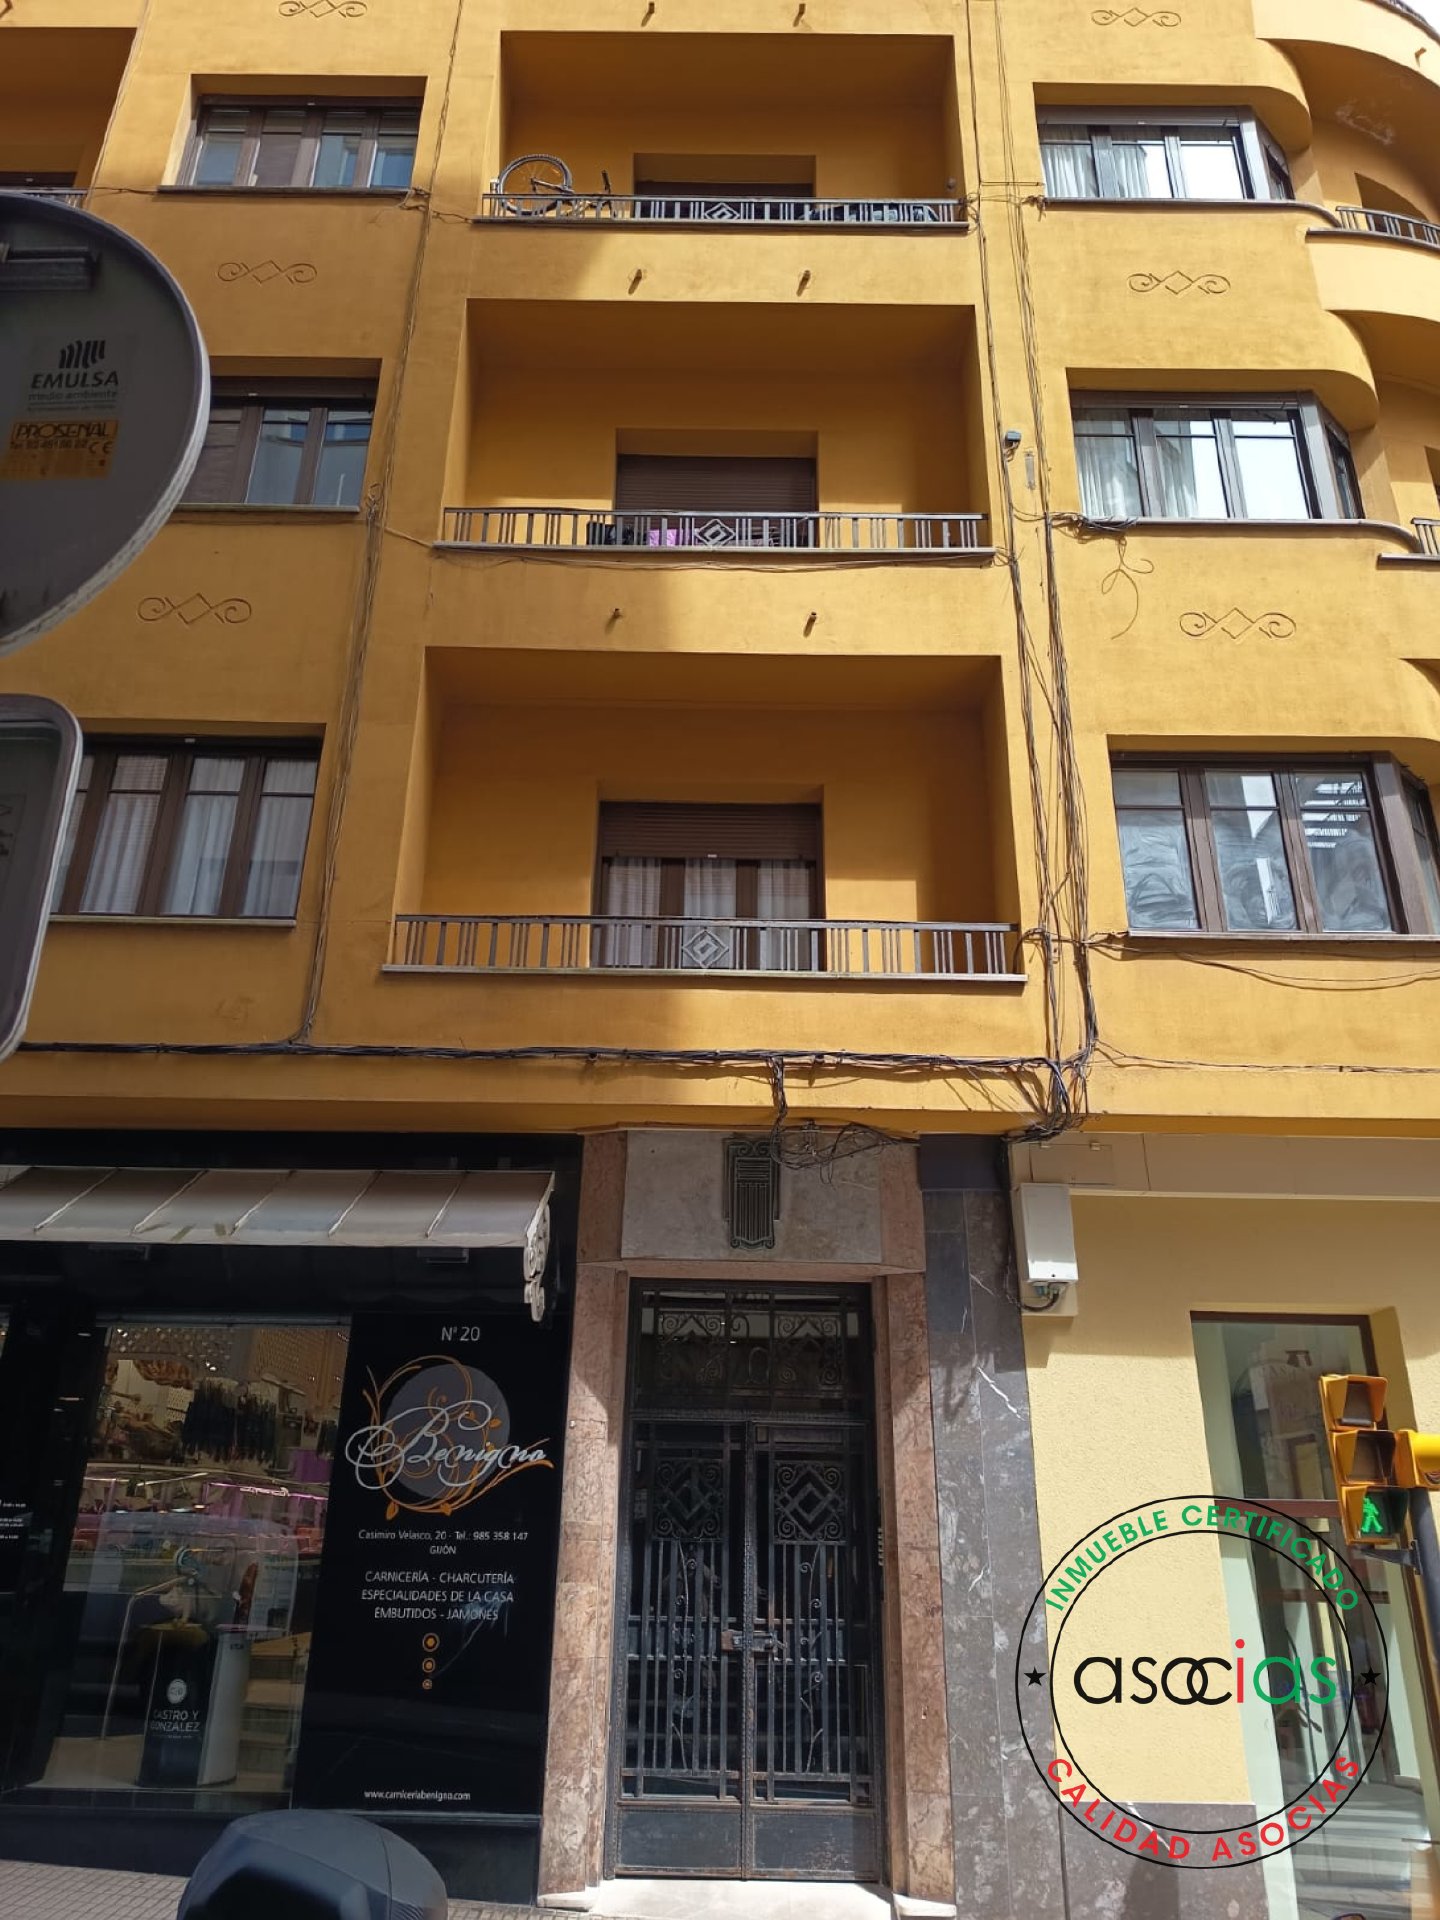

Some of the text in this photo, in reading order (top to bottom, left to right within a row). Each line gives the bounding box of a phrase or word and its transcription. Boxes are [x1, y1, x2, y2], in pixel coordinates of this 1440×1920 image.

[31, 370, 119, 389] EMULSA
[16, 423, 108, 440] PROSENAL
[460, 1326, 480, 1341] 20
[358, 1529, 396, 1539] Casimiro
[398, 1530, 432, 1541] Velasco,
[435, 1530, 447, 1540] 20
[473, 1531, 490, 1540] 985
[493, 1531, 510, 1541] 358
[513, 1532, 529, 1541] 147
[365, 1570, 430, 1583] CARNICERÍA
[439, 1571, 515, 1584] CHARCUTERÍA
[361, 1588, 514, 1602] ESPECIALIDADES DE LA CASA
[374, 1606, 437, 1620] EMBUTIDOS
[446, 1607, 499, 1620] JAMONES
[153, 1710, 199, 1721] CASTRO Y
